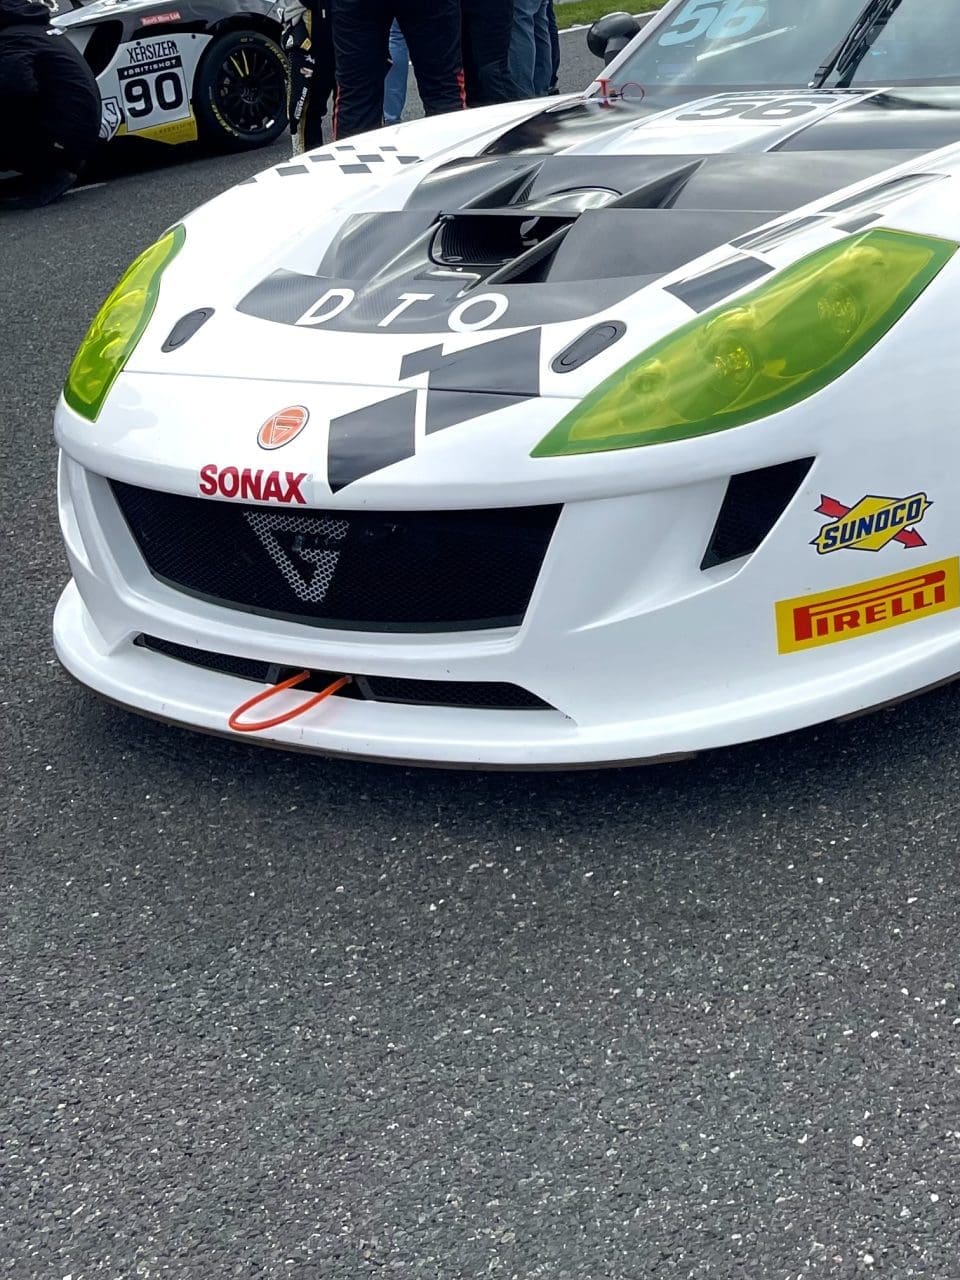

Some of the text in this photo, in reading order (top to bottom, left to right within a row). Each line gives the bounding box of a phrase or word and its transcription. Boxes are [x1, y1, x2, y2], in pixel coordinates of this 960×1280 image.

[124, 71, 184, 119] 90
[675, 97, 838, 121] 56
[294, 288, 509, 334] DTO
[199, 463, 308, 505] SONAX
[822, 497, 923, 550] SUNOCO
[792, 569, 947, 643] PIRELLI
